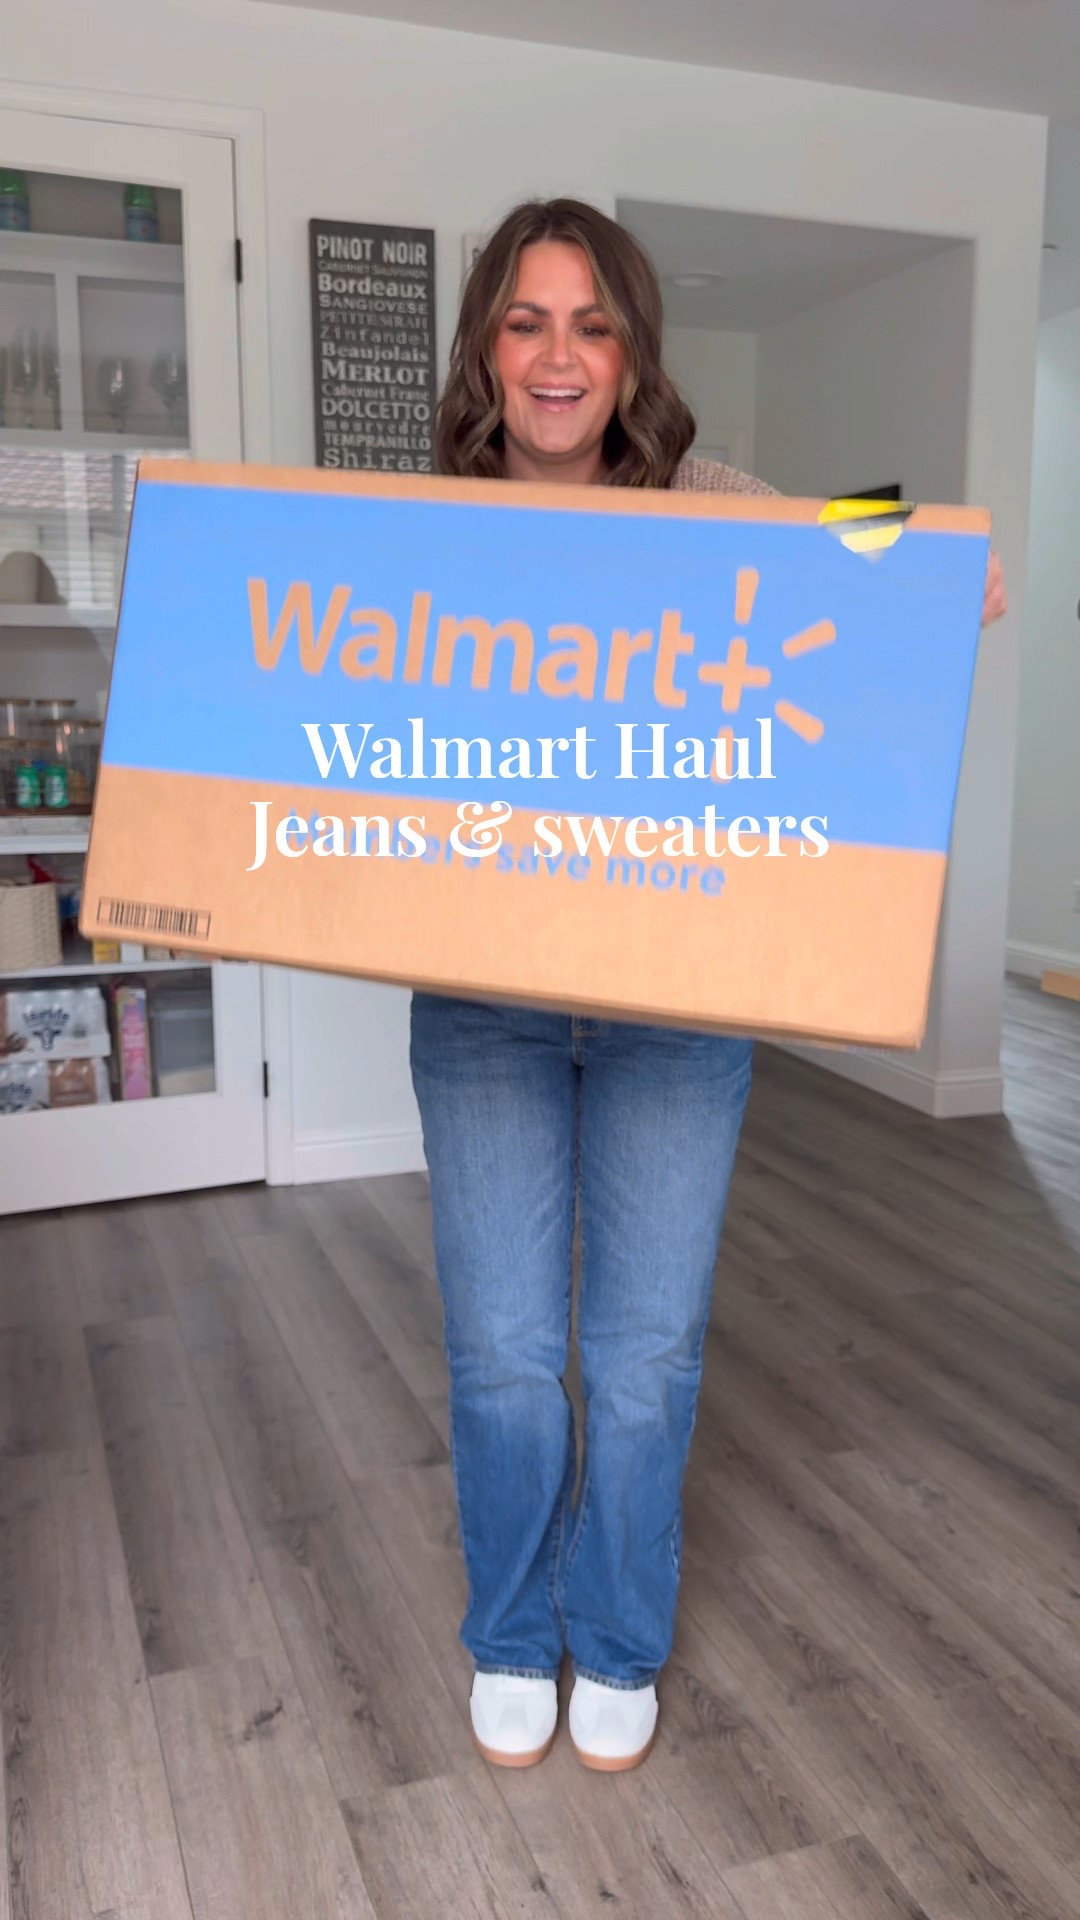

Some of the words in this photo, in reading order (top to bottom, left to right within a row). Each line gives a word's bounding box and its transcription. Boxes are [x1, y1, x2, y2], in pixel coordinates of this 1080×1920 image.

[317, 235, 374, 261] PINOT
[382, 241, 427, 266] NOIR
[318, 273, 427, 299] Bordeaux
[319, 294, 428, 315] SANGIOVESE
[320, 325, 429, 345] Zinfandel
[321, 341, 429, 363] Beaujolais
[321, 358, 429, 386] MERLOT
[321, 398, 431, 422] DOLCETTO
[324, 432, 432, 451] TEMPRANILLO
[323, 447, 432, 472] Shiraz
[605, 852, 726, 897] more
